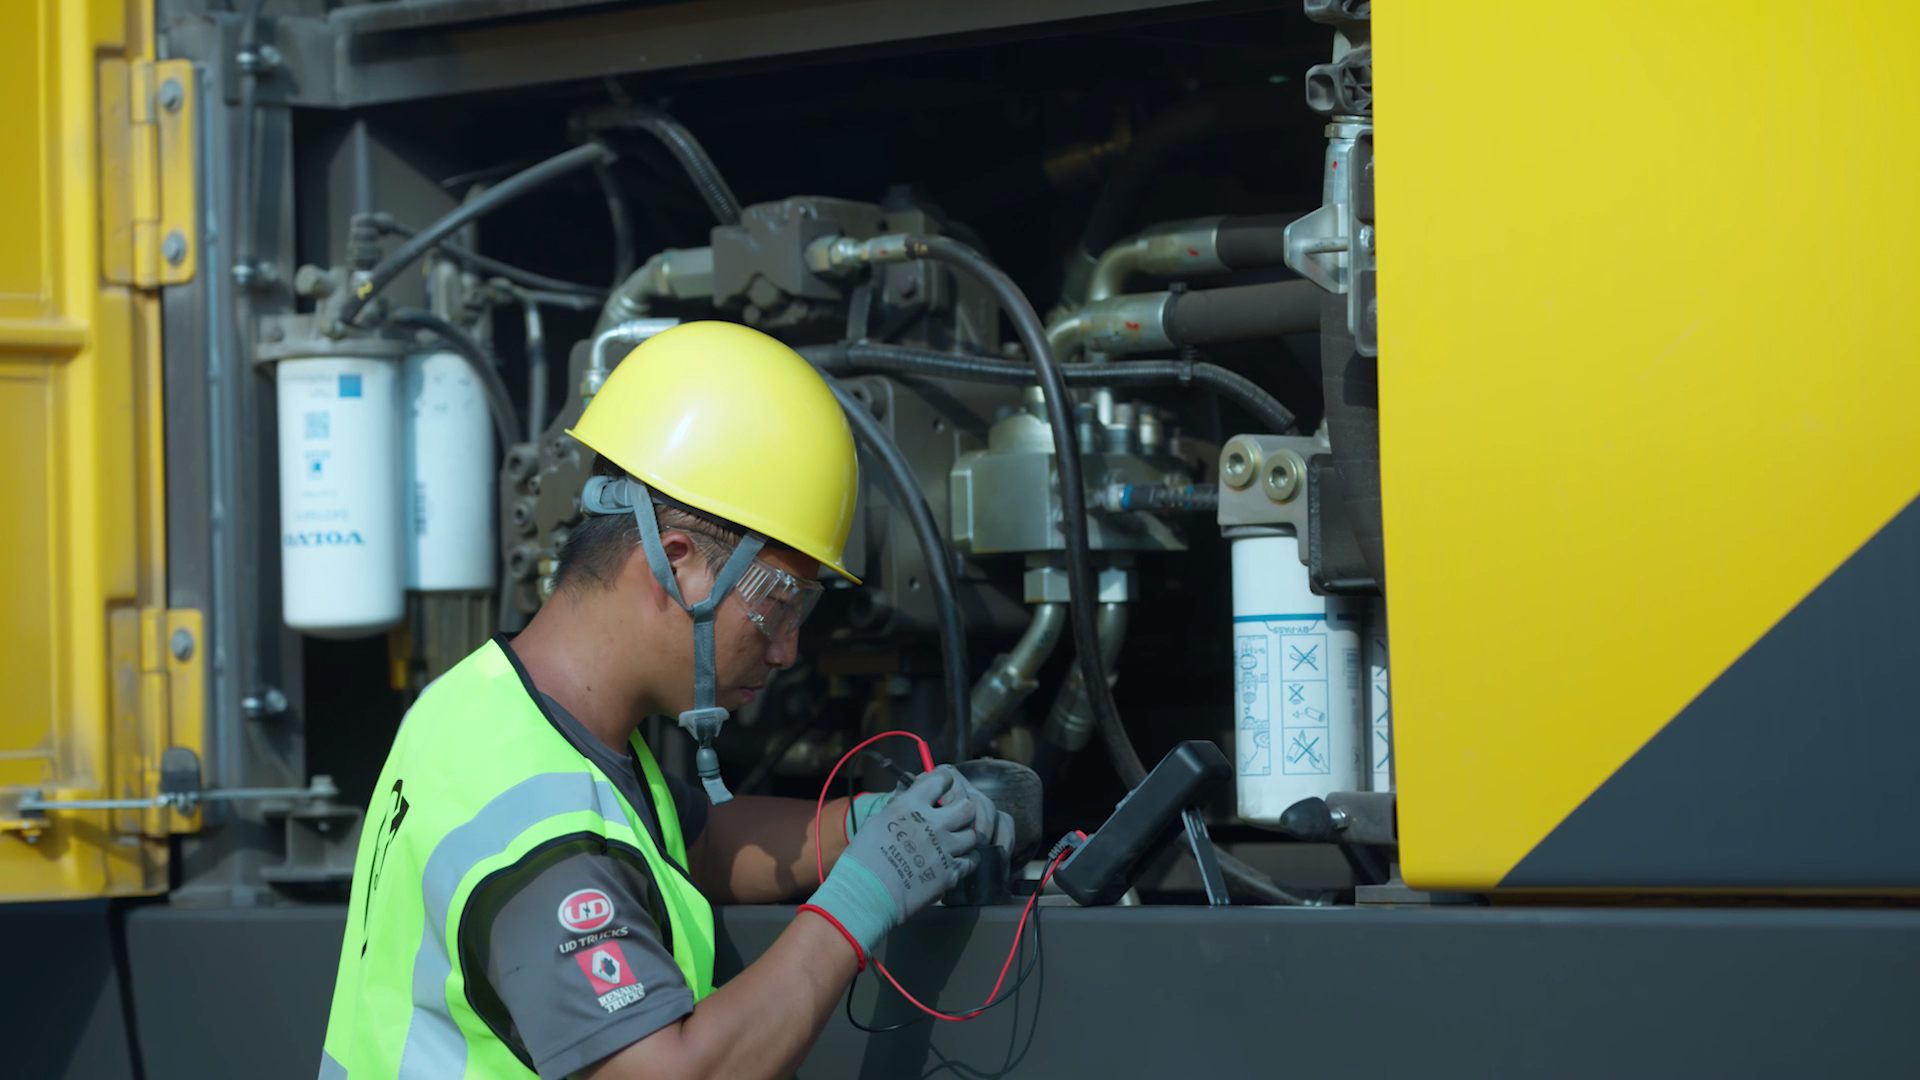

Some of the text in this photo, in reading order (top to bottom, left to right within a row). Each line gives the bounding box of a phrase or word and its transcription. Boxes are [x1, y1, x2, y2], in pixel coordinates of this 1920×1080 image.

[889, 844, 914, 879] FLEXTON
[564, 898, 610, 924] UD
[559, 926, 629, 954] UD TRUCKS
[597, 982, 645, 1008] RENAULT
[604, 990, 646, 1014] TRUCKS
